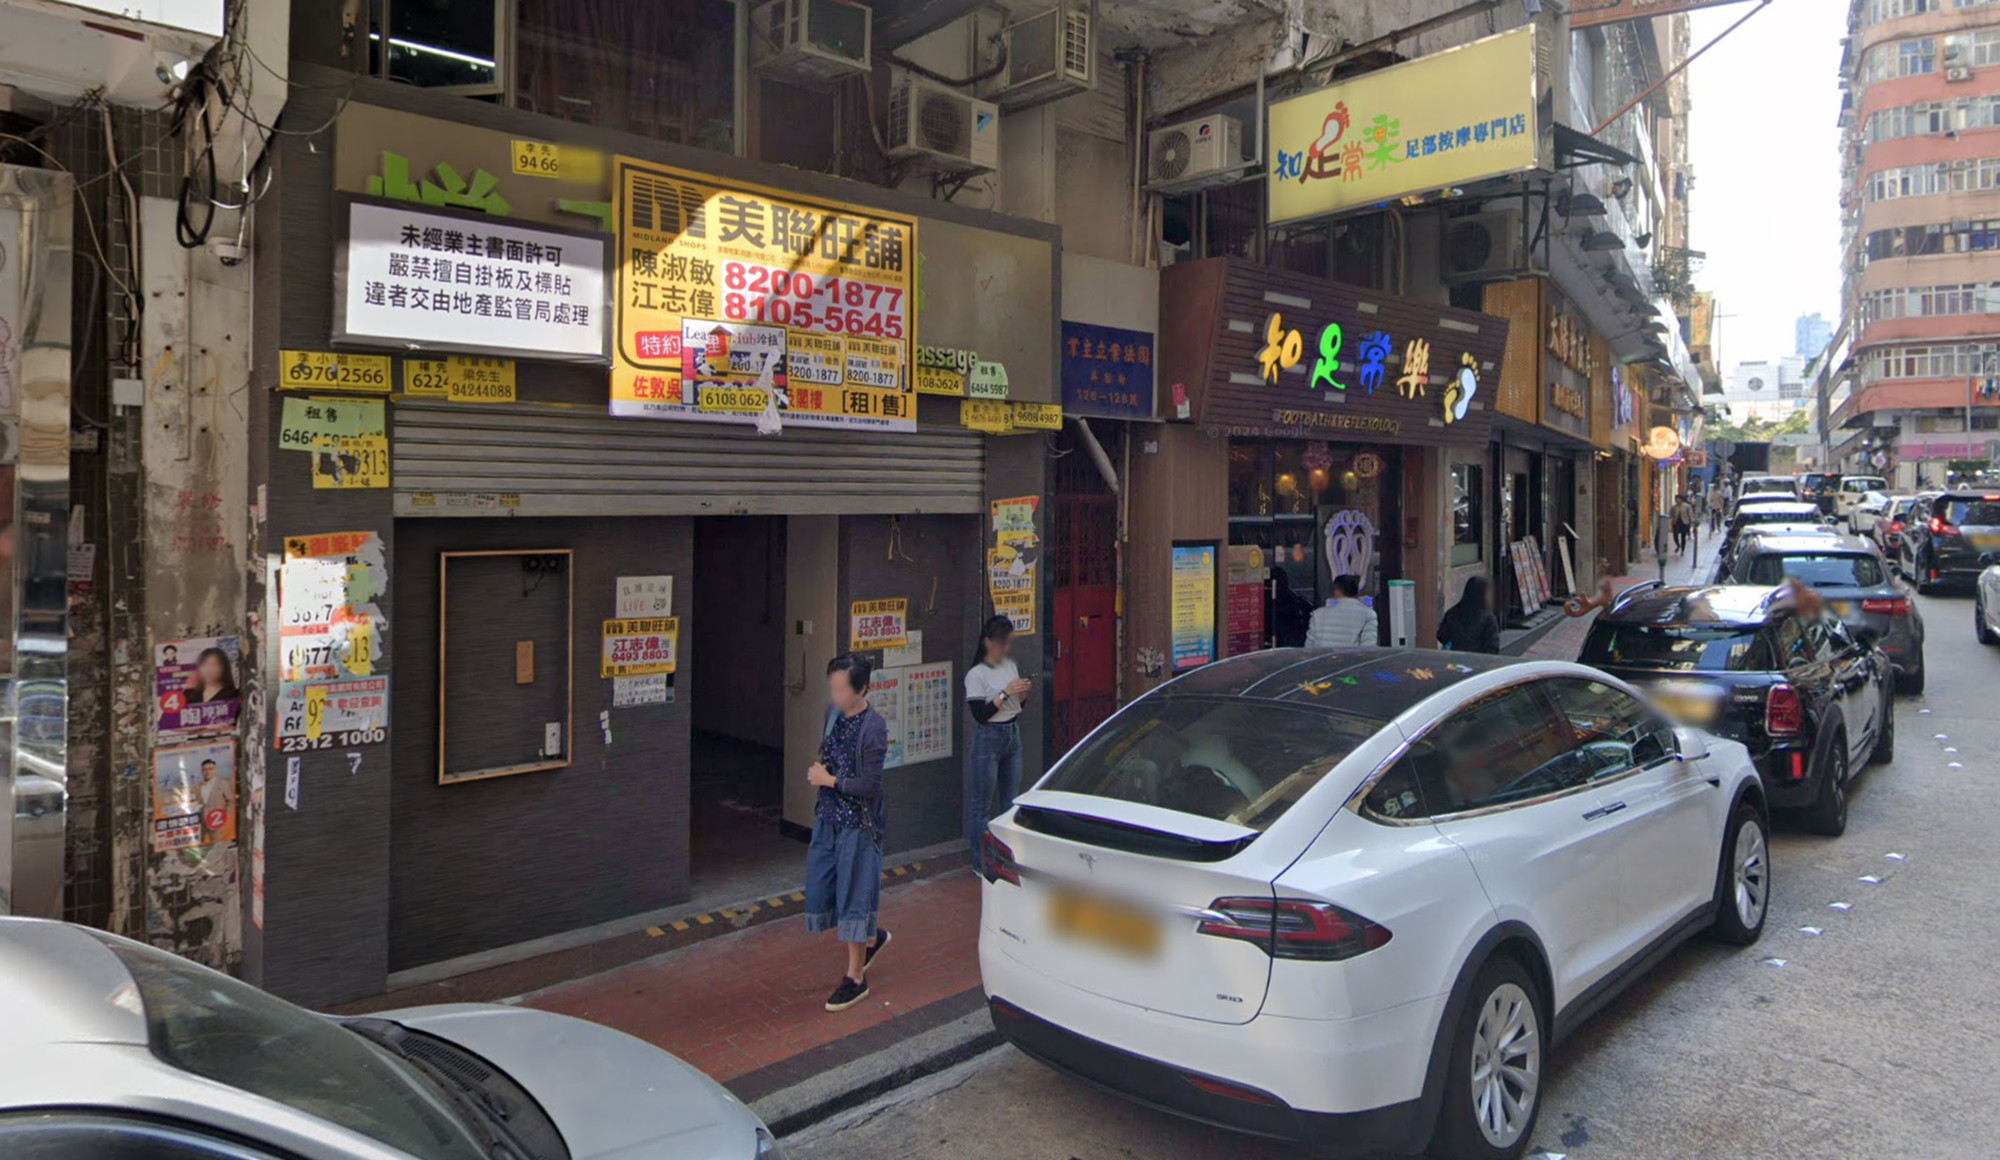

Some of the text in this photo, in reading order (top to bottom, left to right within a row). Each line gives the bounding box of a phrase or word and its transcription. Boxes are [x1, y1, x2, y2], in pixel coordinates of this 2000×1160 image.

[1405, 114, 1526, 160] 足部按摩專門店
[401, 225, 563, 268] 未經業主書面許可
[632, 232, 706, 250] MIDLAND SHOPS
[388, 253, 571, 297] 嚴禁擅自掛板及標貼
[632, 247, 715, 287] 陳淑敏
[725, 262, 903, 312] 8200-1877
[365, 281, 589, 327] 違者交由地產監管局處理
[631, 280, 715, 318] 江志偉
[725, 293, 903, 339] 8105-5645
[917, 345, 979, 374] assage
[341, 367, 384, 384] 2566
[918, 376, 934, 389] 108
[452, 382, 512, 398] 94244088
[706, 392, 737, 405] 6108
[304, 406, 338, 423] 租售
[623, 600, 645, 612] LIVE
[859, 616, 894, 629] 江志偉
[613, 636, 660, 653] 江志偉
[611, 650, 669, 663] 9493 8803
[164, 694, 180, 709] 4
[282, 728, 386, 752] 2312 1000
[210, 811, 224, 827] 2
